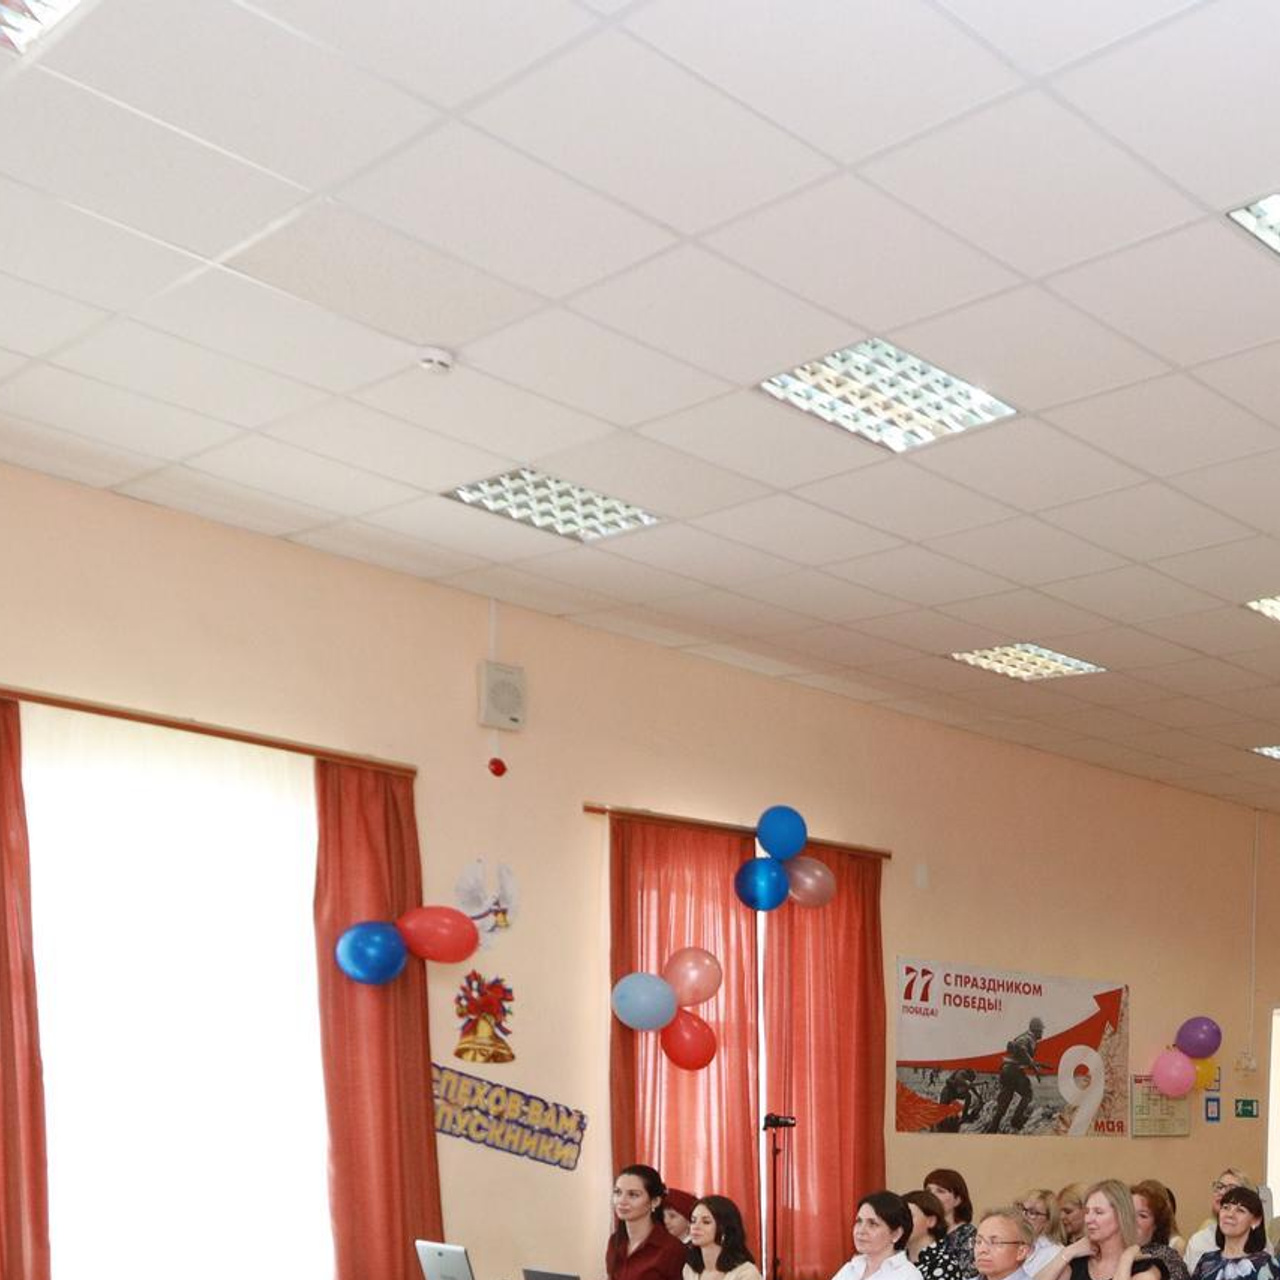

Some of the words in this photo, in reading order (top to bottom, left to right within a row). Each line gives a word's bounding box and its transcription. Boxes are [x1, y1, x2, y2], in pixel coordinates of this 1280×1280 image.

[904, 966, 933, 1002] 77
[944, 973, 951, 986] С
[954, 974, 1043, 996] ПРАЗДНИКОМ
[943, 993, 1002, 1012] ПОБЕДЫ!
[434, 1102, 578, 1168] ПУСКНИКИ
